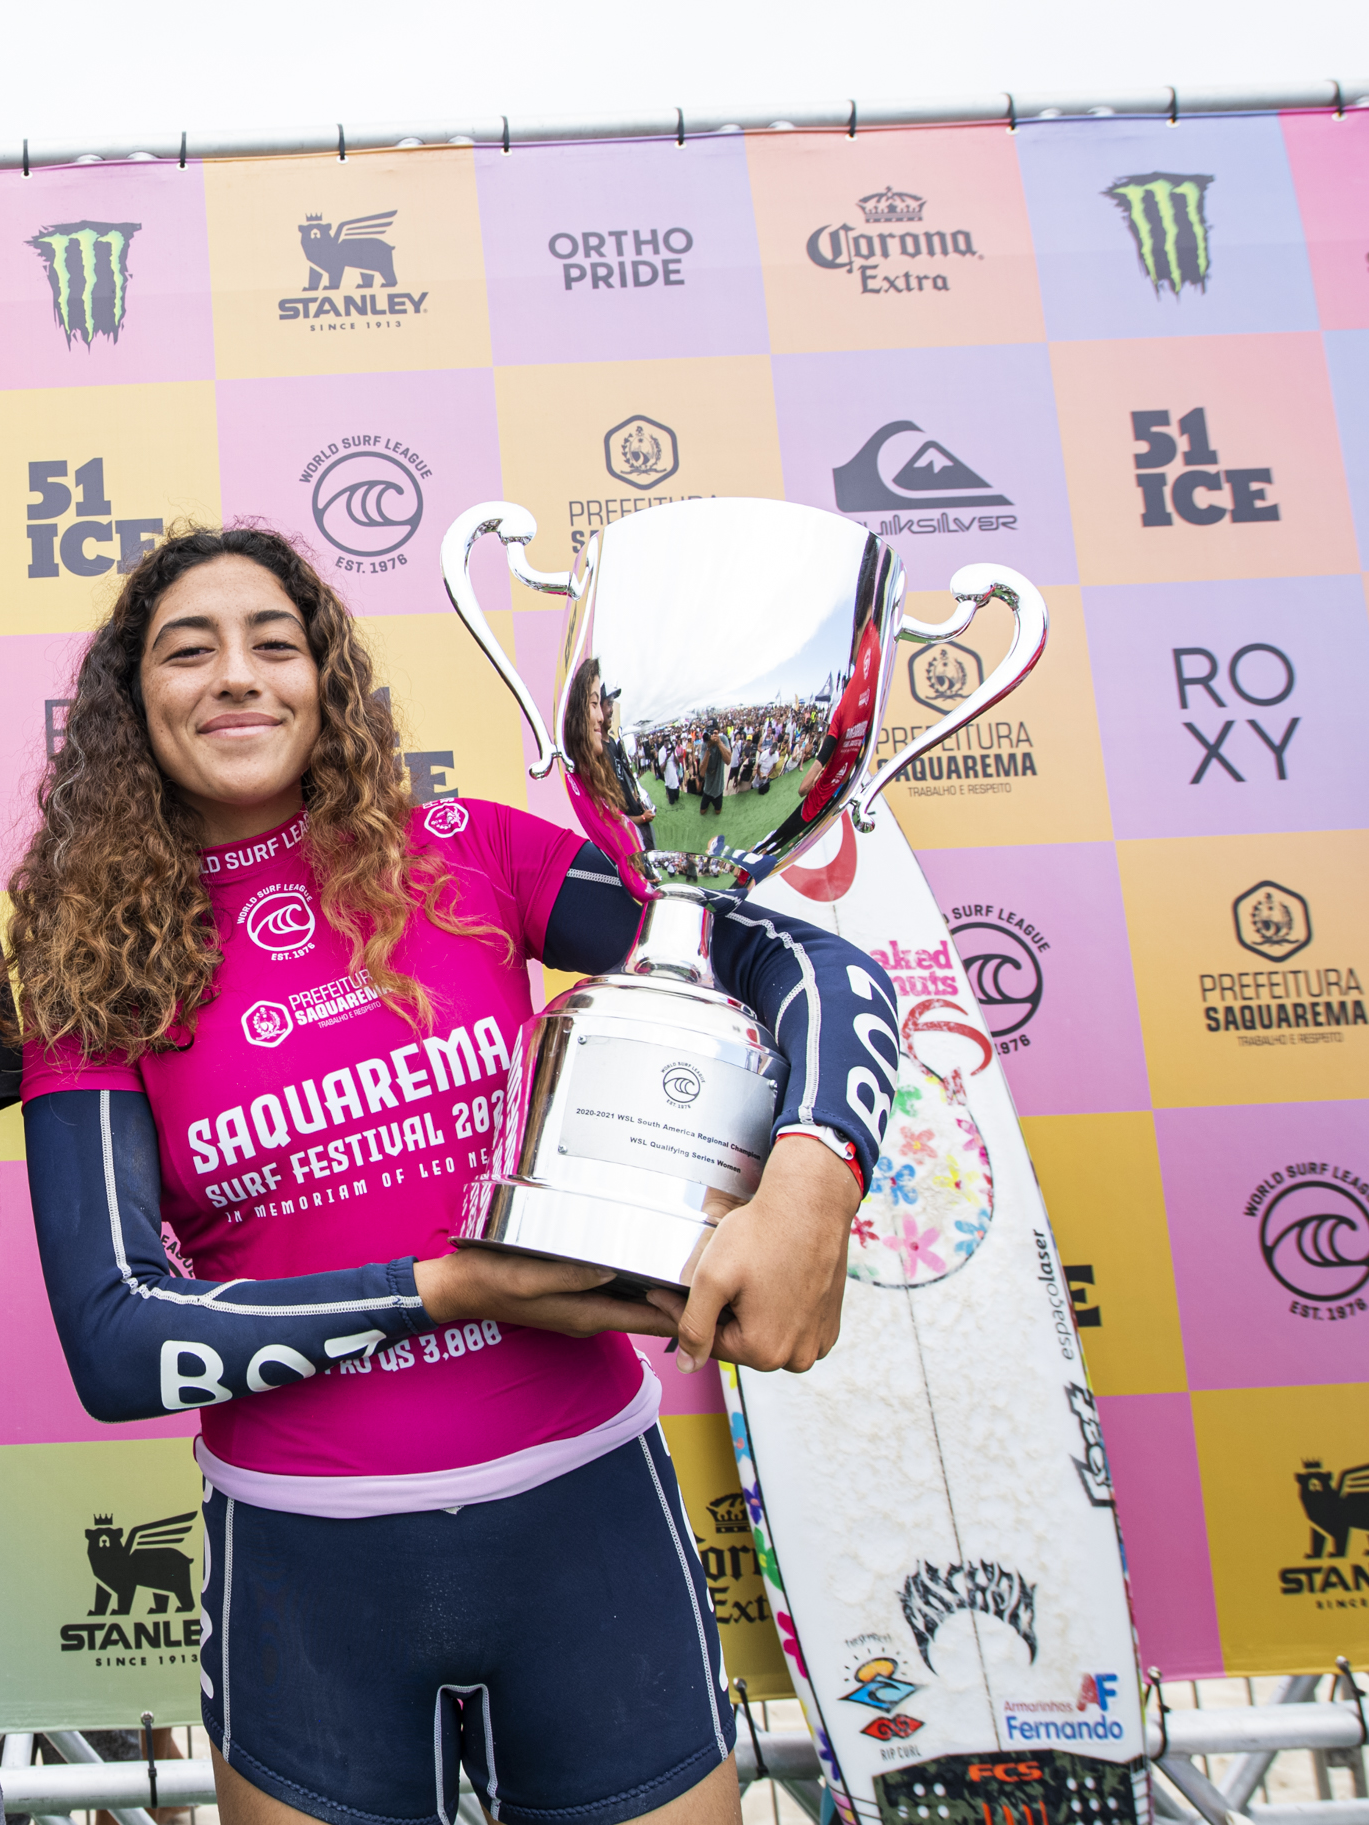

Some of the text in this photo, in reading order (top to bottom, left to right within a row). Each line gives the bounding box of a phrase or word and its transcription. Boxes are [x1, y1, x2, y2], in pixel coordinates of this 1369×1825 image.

[548, 227, 693, 259] ORTHO
[805, 222, 978, 275] Corona
[562, 258, 685, 291] PRIDE
[858, 264, 950, 294] Extra
[278, 291, 429, 320] STANLEY
[310, 321, 402, 332] SINCE 1913
[1130, 407, 1219, 470] 51
[299, 435, 433, 483] WORLD SURF LEAGUE
[27, 458, 112, 521] 51
[1135, 467, 1281, 528] ICE
[335, 553, 408, 574] EST. 1976
[1172, 642, 1296, 710] RO
[1182, 716, 1302, 785] XY
[908, 782, 1012, 797] TRABALHO E RESPEITO
[224, 837, 279, 870] SURF
[236, 883, 313, 925] WORLD SURF LEAGUE
[951, 904, 1051, 953] SURF LEAGUE
[271, 942, 315, 961] EST. 1976
[288, 968, 374, 1011] PREFEITUR
[1199, 967, 1365, 1003] PREFEITURA
[317, 1001, 382, 1029] TRABALHO E RESPEITO
[1204, 1000, 1369, 1032] SAQUAREMA
[1237, 1032, 1345, 1047] TRABALHO E RESPEITO
[187, 1015, 511, 1176] SAQUAREMA
[204, 1162, 282, 1209] SURF
[290, 1112, 445, 1185] FESTIVAL
[451, 1089, 505, 1140] 202
[576, 1108, 761, 1161] 2020-2021 WSL South America Regional Champion
[630, 1136, 741, 1174] WSL Qualifying Series Women
[256, 1178, 368, 1218] MEMORIAM
[382, 1168, 406, 1188] OF
[419, 1156, 455, 1178] LEO
[1243, 1162, 1369, 1217] WORLD SURF LEAG
[1038, 1229, 1074, 1361] espaçolaser
[1289, 1298, 1368, 1321] EST. 1976
[381, 1339, 415, 1372] QS
[420, 1319, 503, 1364] 3,000
[1278, 1564, 1369, 1595] STAN
[709, 1586, 771, 1626] Ext
[60, 1619, 202, 1652] STANLE
[95, 1653, 199, 1667] SINCE 1913
[1003, 1700, 1073, 1713] Armarinhos
[1005, 1715, 1123, 1740] Fernando
[880, 1745, 922, 1761] RIP CURL
[968, 1761, 1043, 1783] FCS
